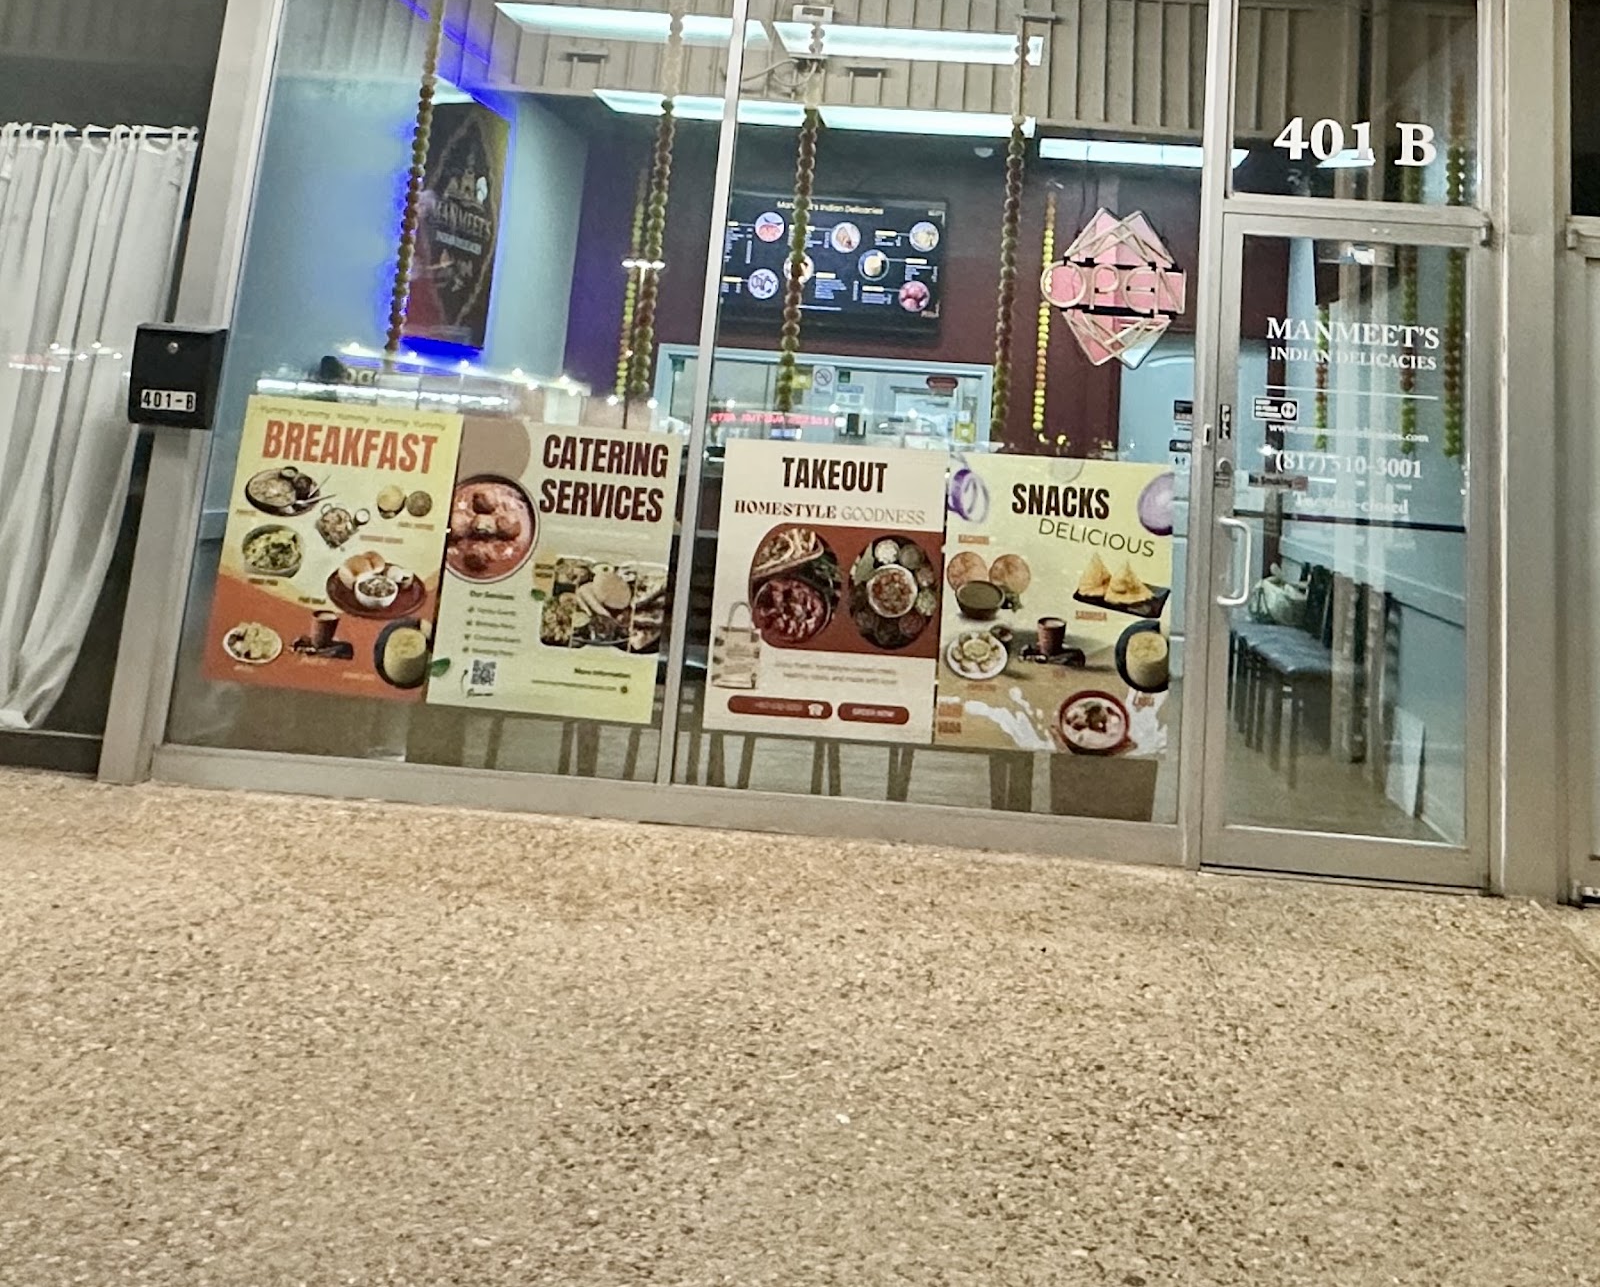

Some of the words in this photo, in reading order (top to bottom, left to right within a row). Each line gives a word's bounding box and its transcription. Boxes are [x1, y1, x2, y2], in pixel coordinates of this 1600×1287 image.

[1273, 116, 1373, 162] 401
[1394, 122, 1437, 166] B
[1040, 260, 1187, 318] OPEN
[1266, 317, 1440, 350] MANMEET'S
[1270, 346, 1332, 364] INDIAN
[1337, 350, 1437, 370] DELICACIES
[141, 391, 194, 411] 401-B
[262, 419, 438, 474] BREAKFAST
[543, 434, 669, 478] CATERING
[782, 457, 888, 493] TAKEOUT
[540, 478, 664, 522] SERVICES
[734, 500, 836, 519] HOMESTYLE
[841, 505, 926, 525] GOODNESS
[1012, 483, 1110, 520] SNACKS
[1039, 518, 1155, 557] DELICIOUS
